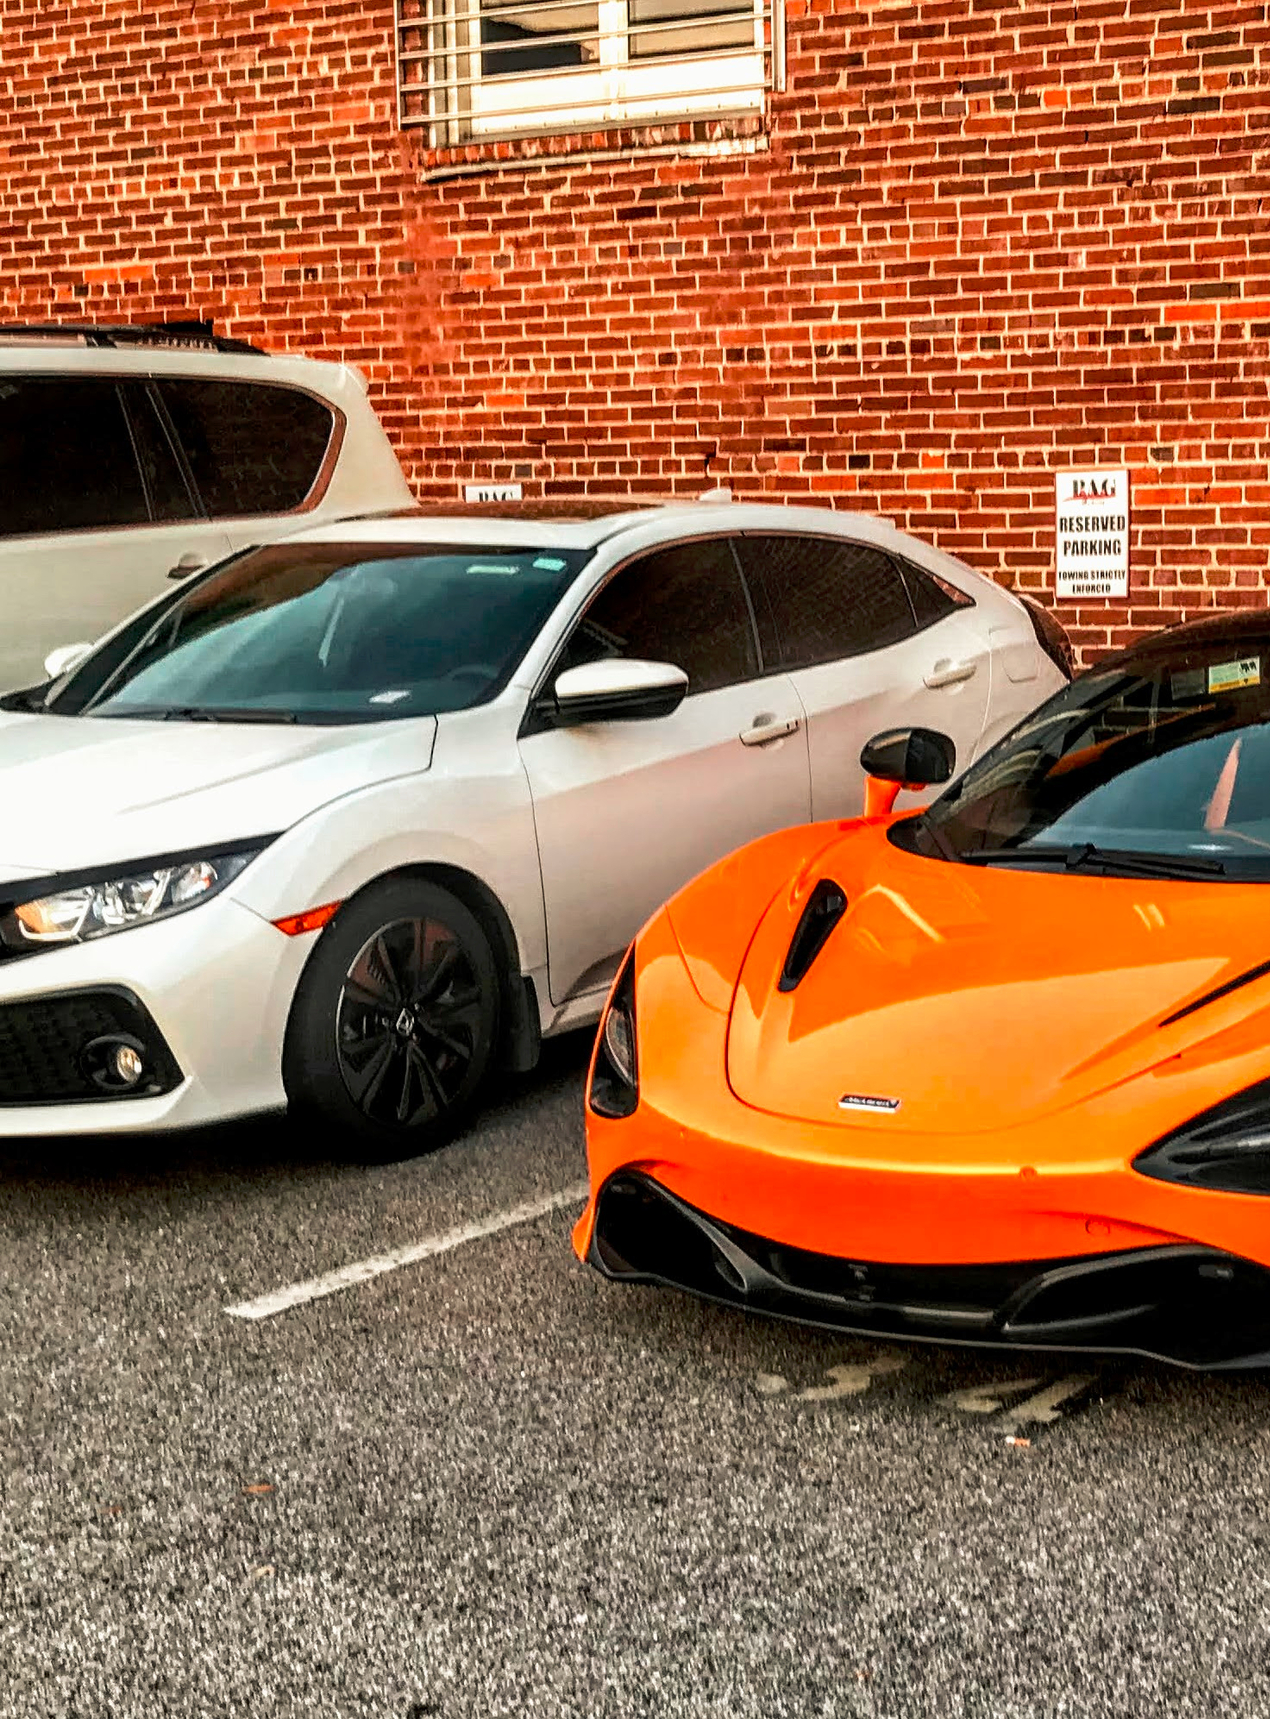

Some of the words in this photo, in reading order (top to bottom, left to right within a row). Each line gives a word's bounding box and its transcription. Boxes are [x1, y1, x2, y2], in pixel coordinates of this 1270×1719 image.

[1059, 515, 1126, 533] RESERVED
[1063, 539, 1121, 556] PARKING
[1058, 570, 1089, 581] TOWING
[1090, 569, 1126, 581] STRICTLY
[1072, 583, 1111, 594] ENFORCED
